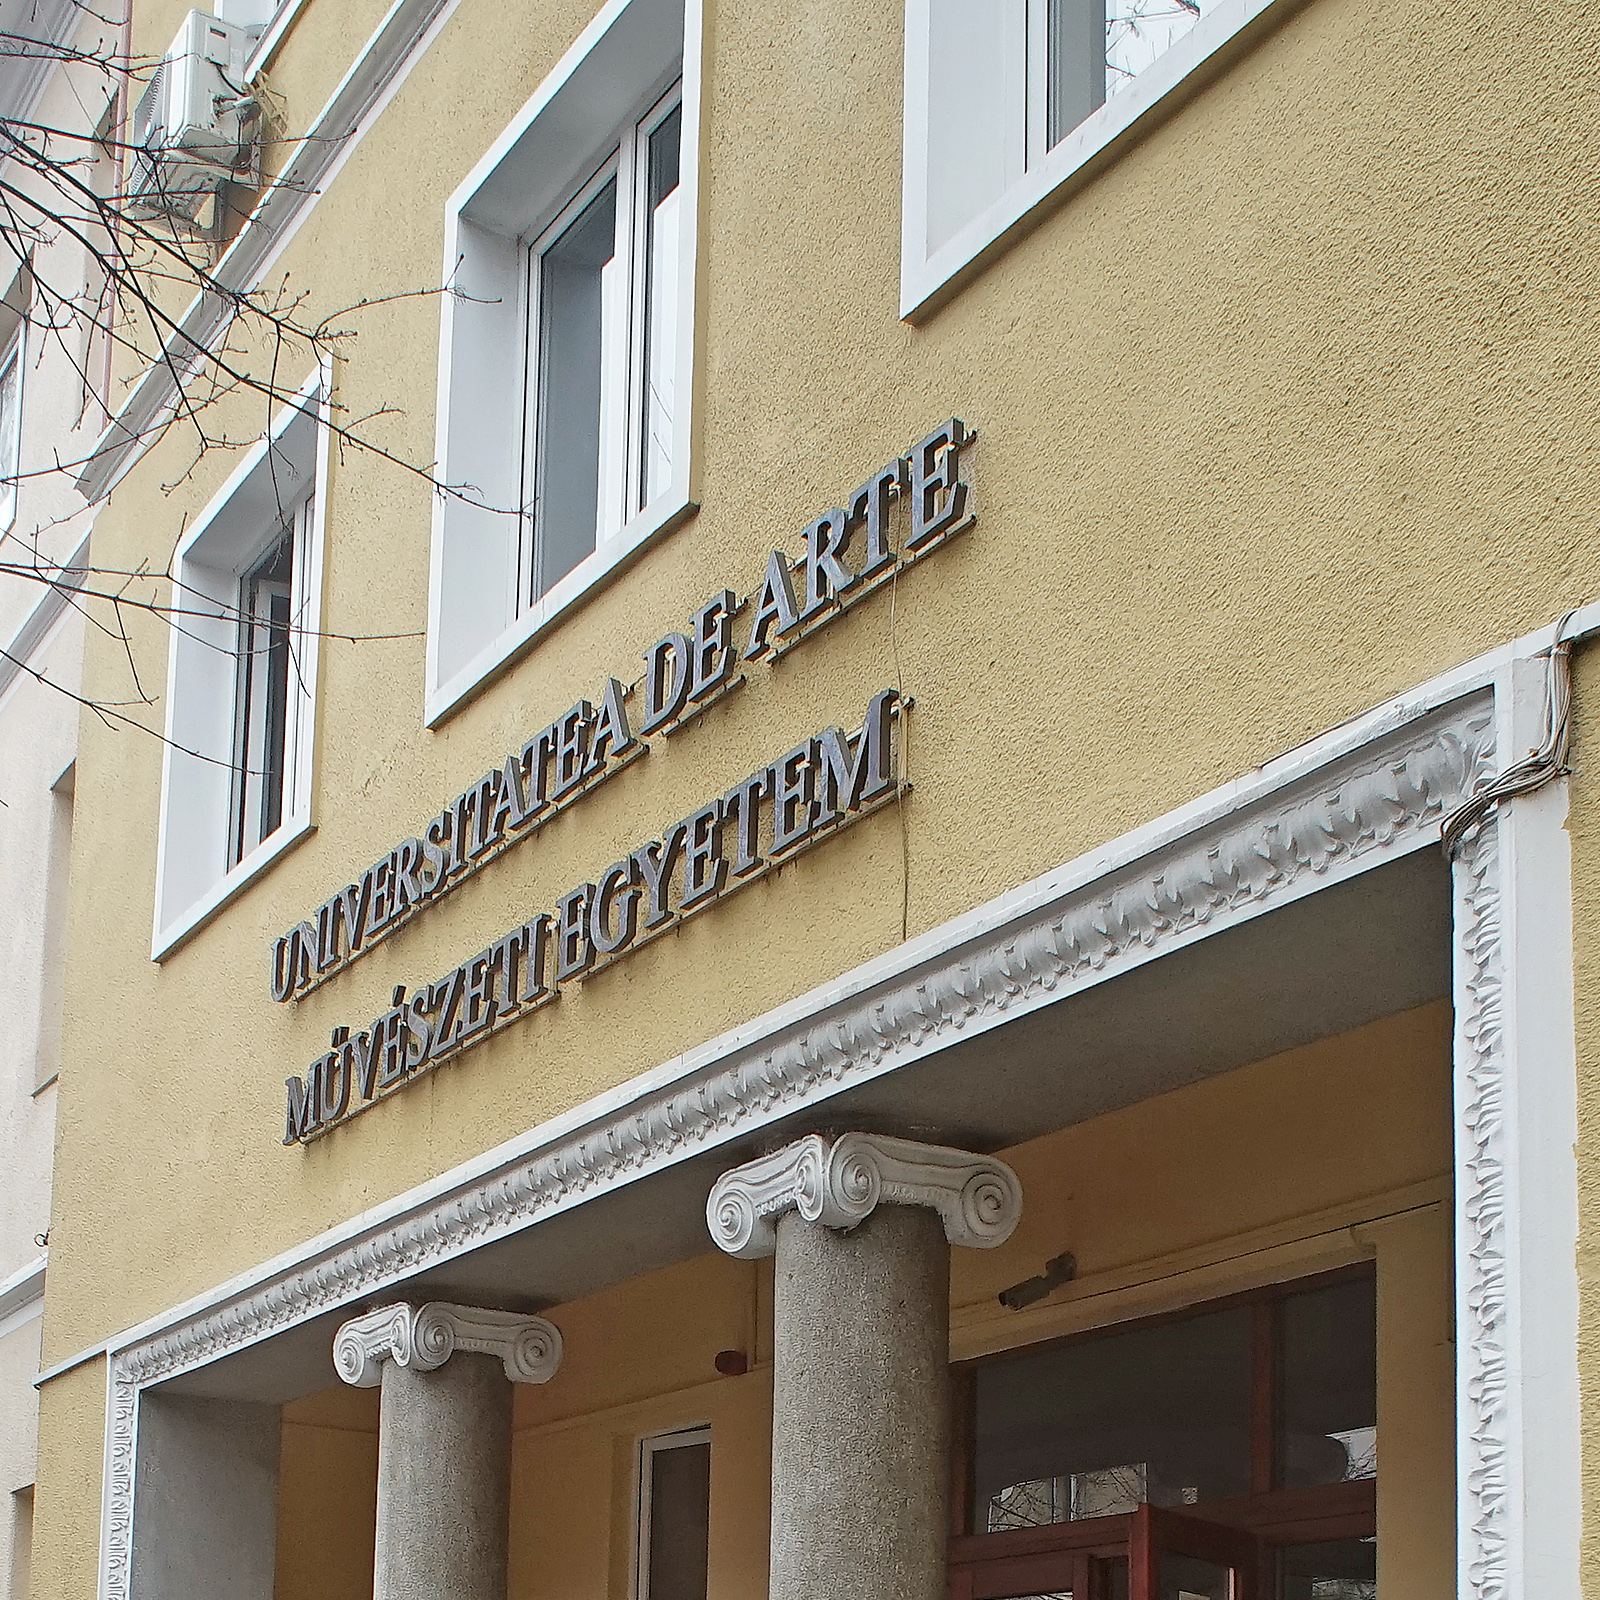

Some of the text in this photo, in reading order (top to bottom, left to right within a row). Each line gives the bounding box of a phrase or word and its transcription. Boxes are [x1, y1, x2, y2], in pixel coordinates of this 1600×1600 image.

[270, 417, 968, 1002] UNIVERSITATEA DE ARTE
[556, 688, 903, 984] EGYETEM
